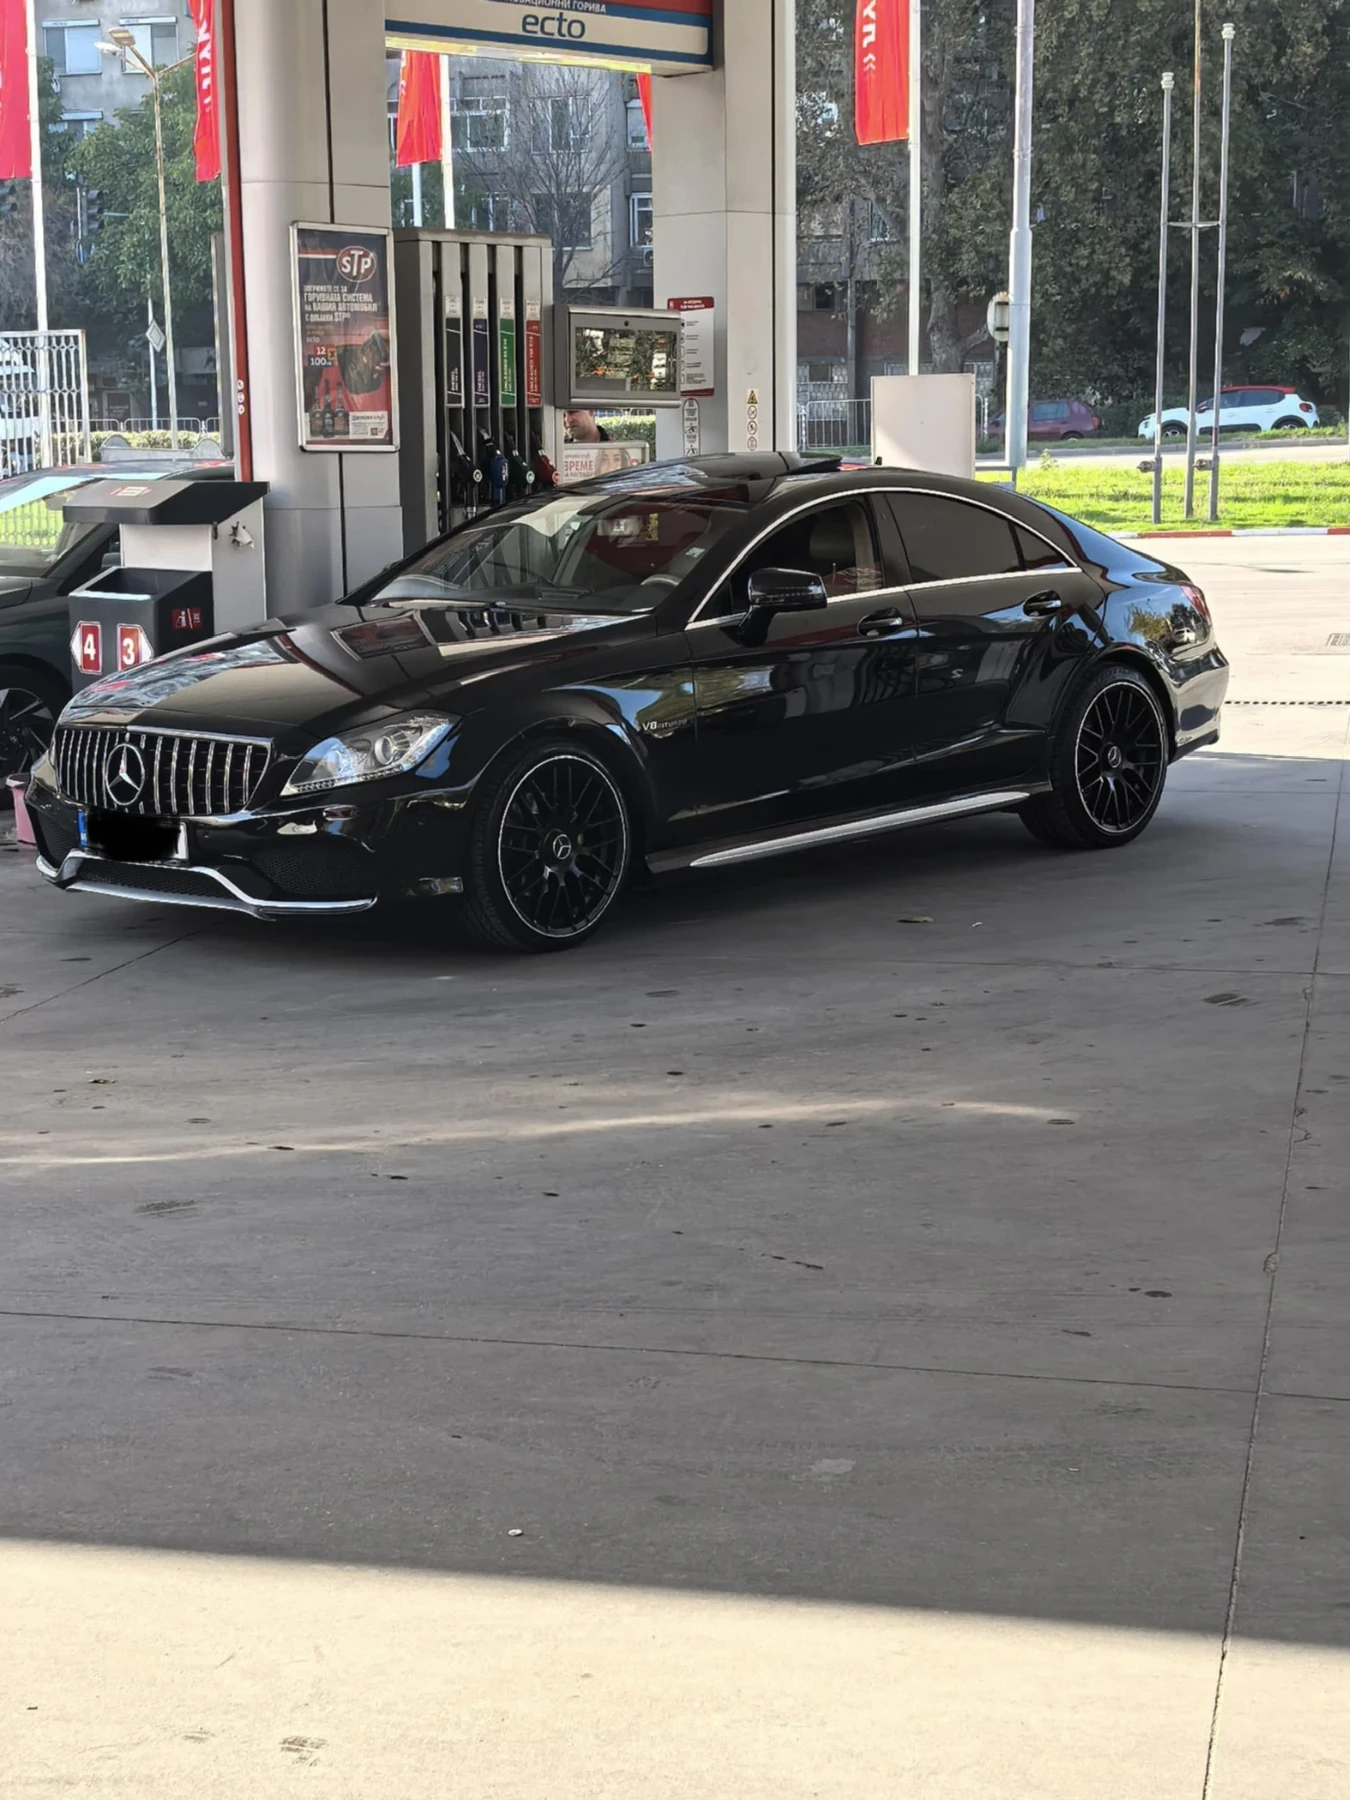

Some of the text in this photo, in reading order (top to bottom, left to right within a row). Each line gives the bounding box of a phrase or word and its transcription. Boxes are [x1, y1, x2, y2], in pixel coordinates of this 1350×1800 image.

[573, 1, 607, 13] ГОРИВА
[522, 12, 585, 38] ecto
[341, 250, 372, 276] STP
[316, 346, 326, 355] 12
[84, 634, 96, 660] 4
[122, 637, 135, 666] 3
[642, 721, 657, 731] V8
